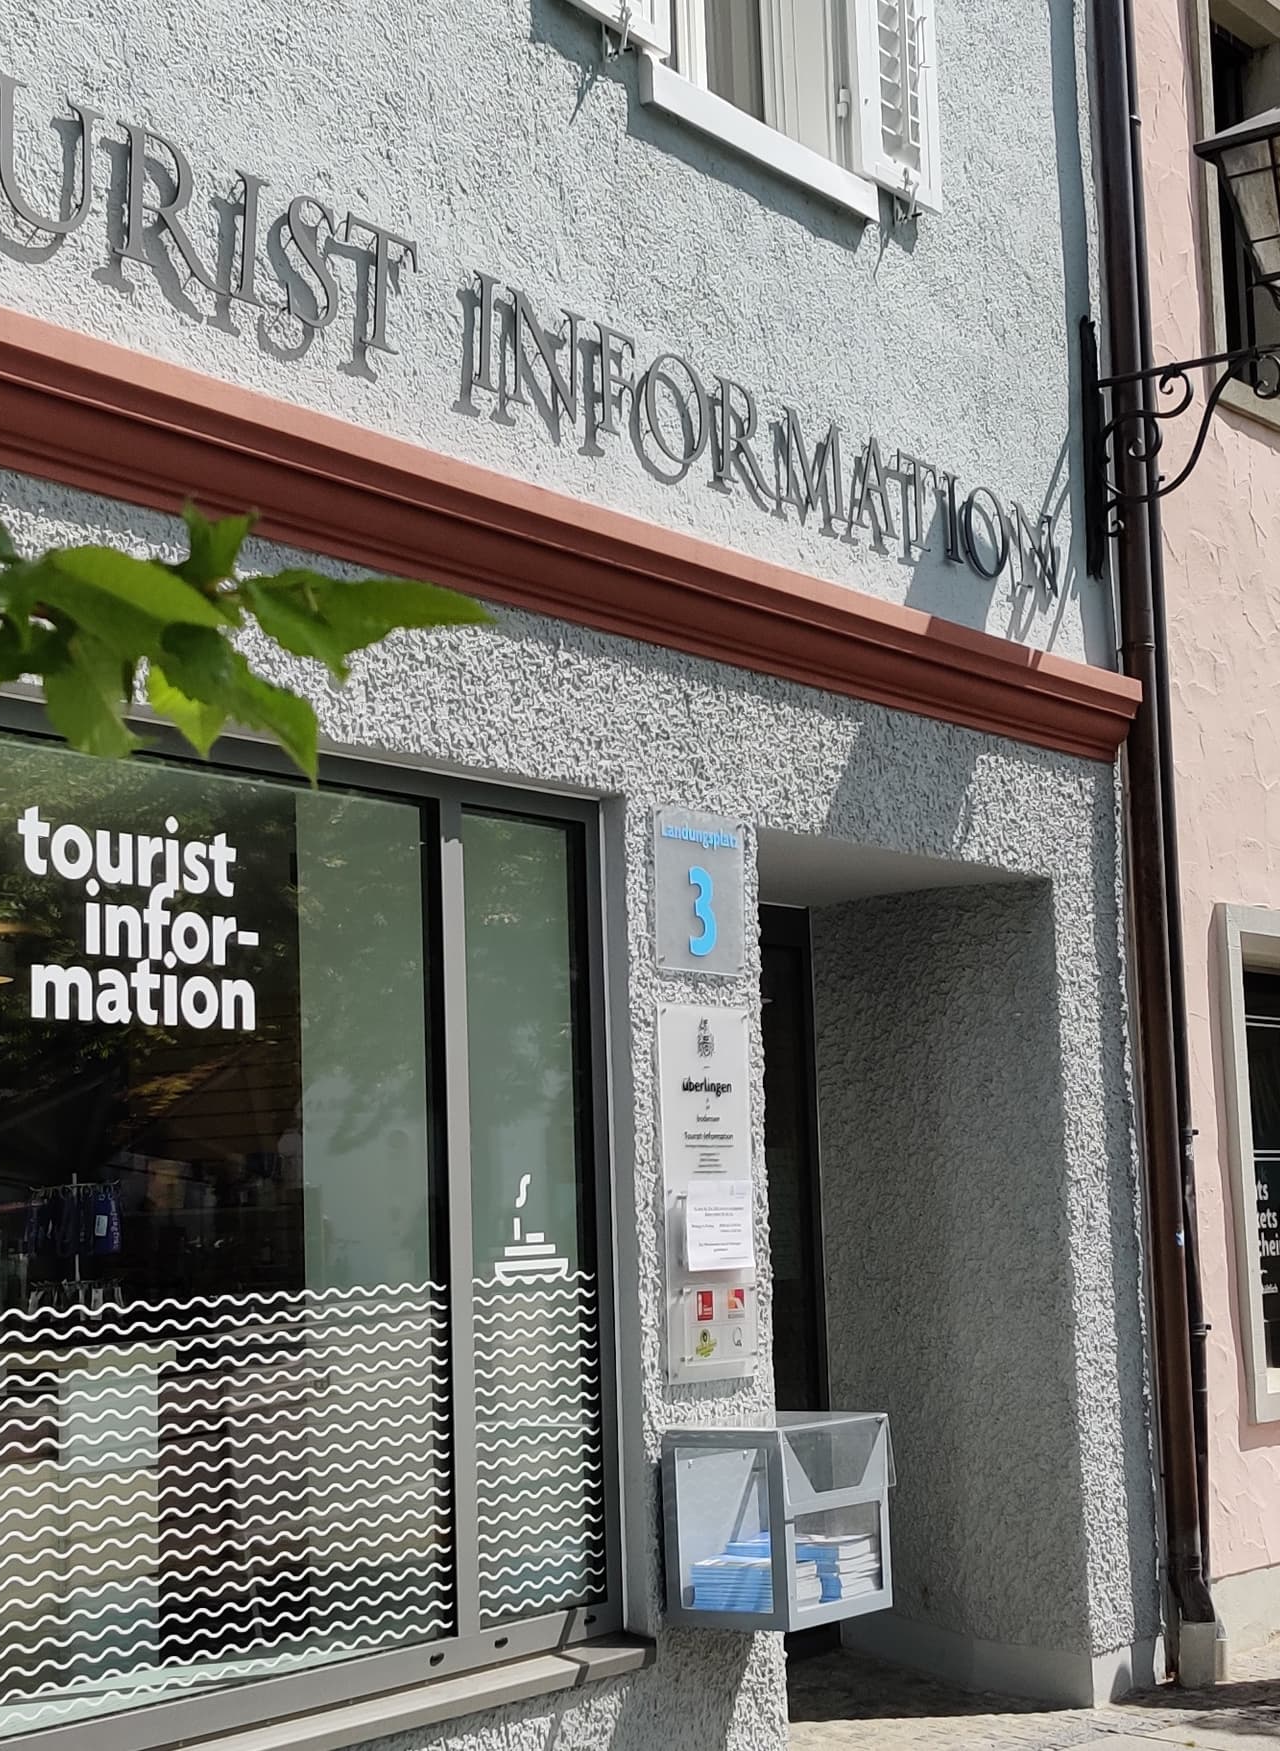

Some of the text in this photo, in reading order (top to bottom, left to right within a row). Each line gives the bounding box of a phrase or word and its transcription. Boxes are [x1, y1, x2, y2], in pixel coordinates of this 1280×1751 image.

[472, 270, 1059, 598] INFORMATION
[17, 806, 237, 897] tourist
[84, 878, 260, 966] infor-
[689, 865, 718, 957] 3
[30, 951, 257, 1031] mation
[682, 1075, 733, 1097] überlingen
